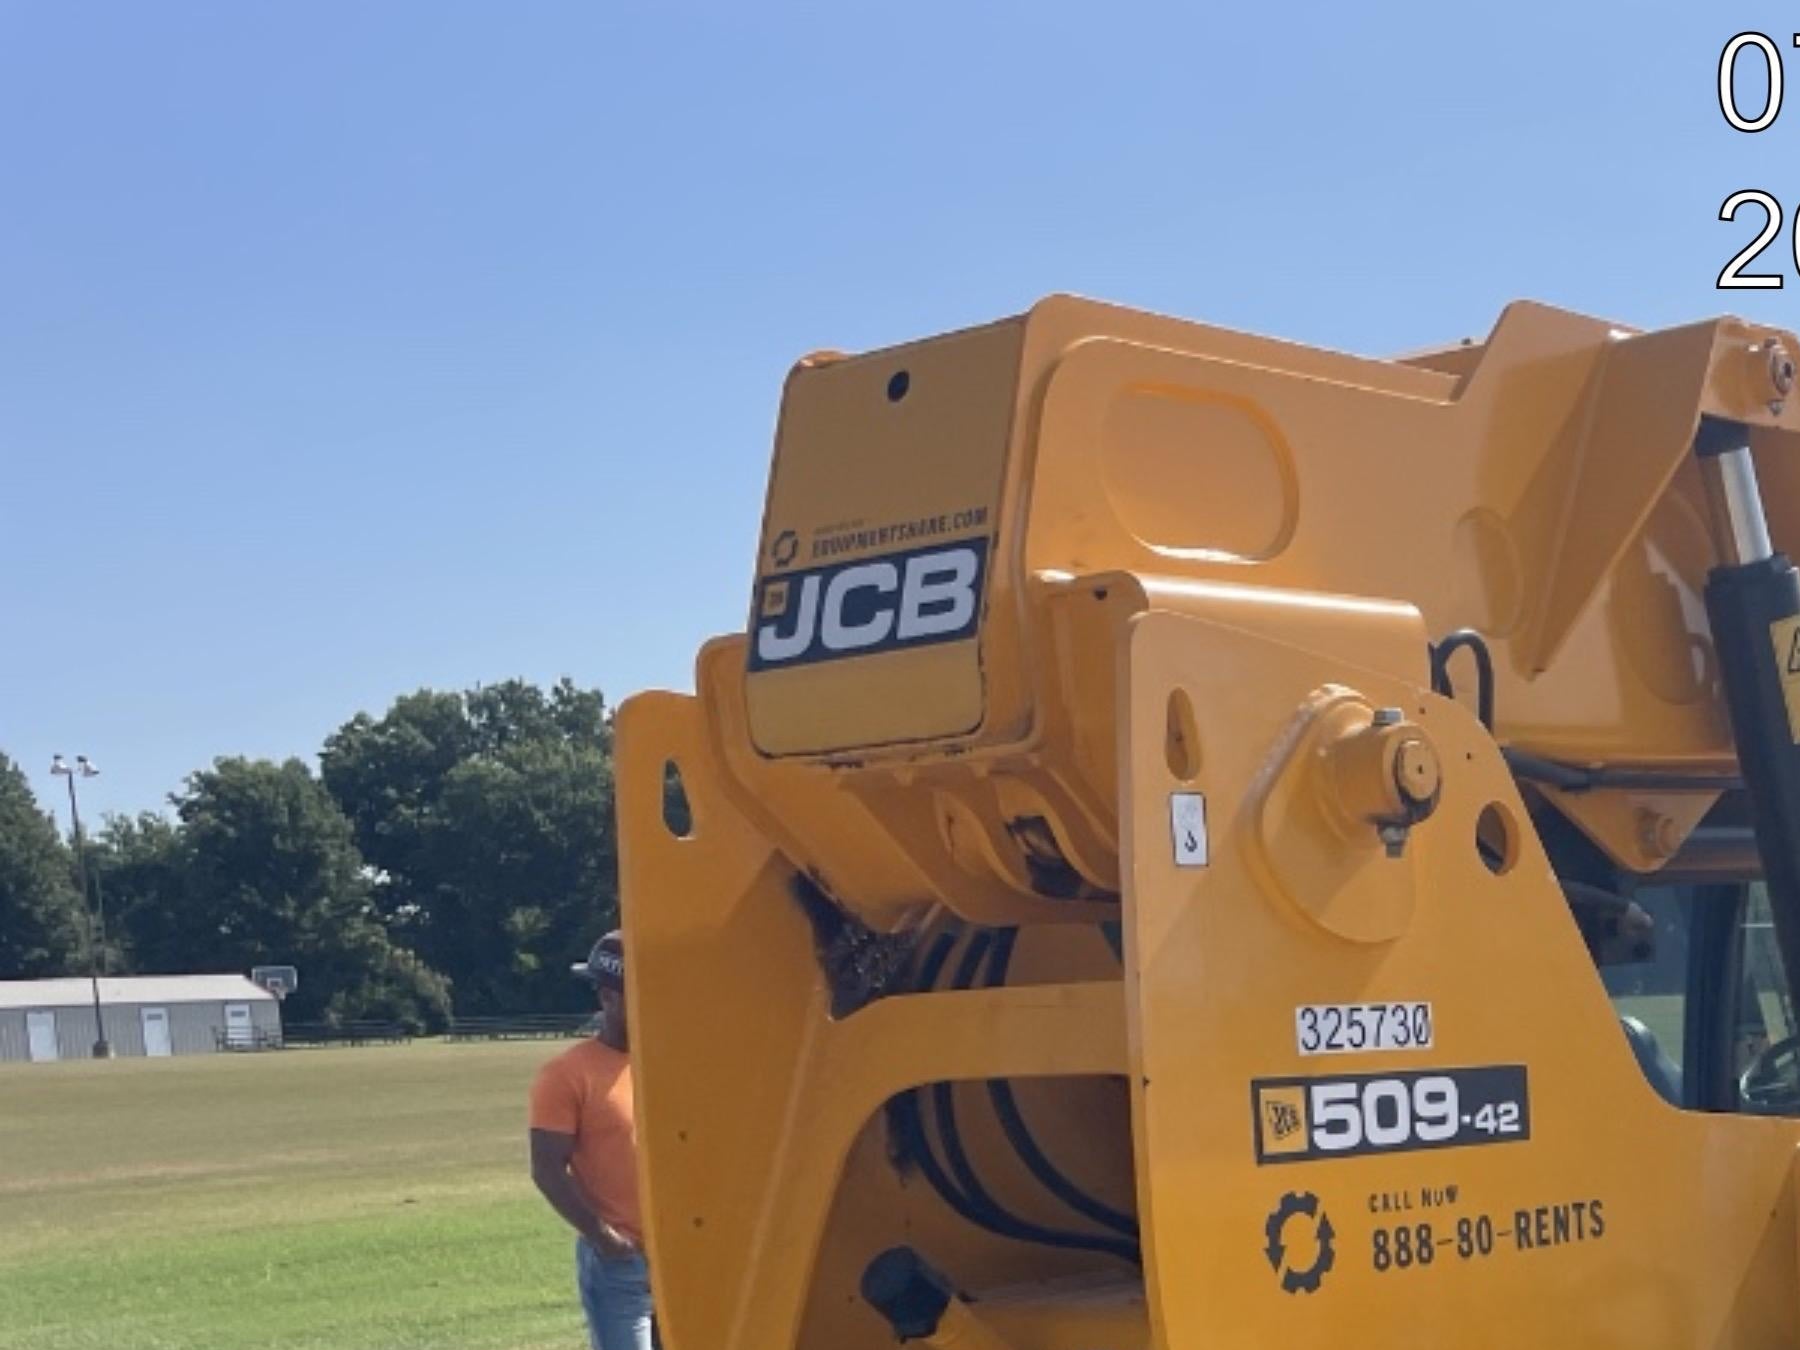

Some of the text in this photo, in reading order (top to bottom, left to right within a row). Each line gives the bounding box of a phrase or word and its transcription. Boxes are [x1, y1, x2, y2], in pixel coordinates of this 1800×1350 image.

[758, 548, 978, 662] JCB
[1300, 1004, 1430, 1050] 325730
[1369, 1190, 1413, 1212] CALL
[1373, 1200, 1604, 1272] 888-80-RENTS
